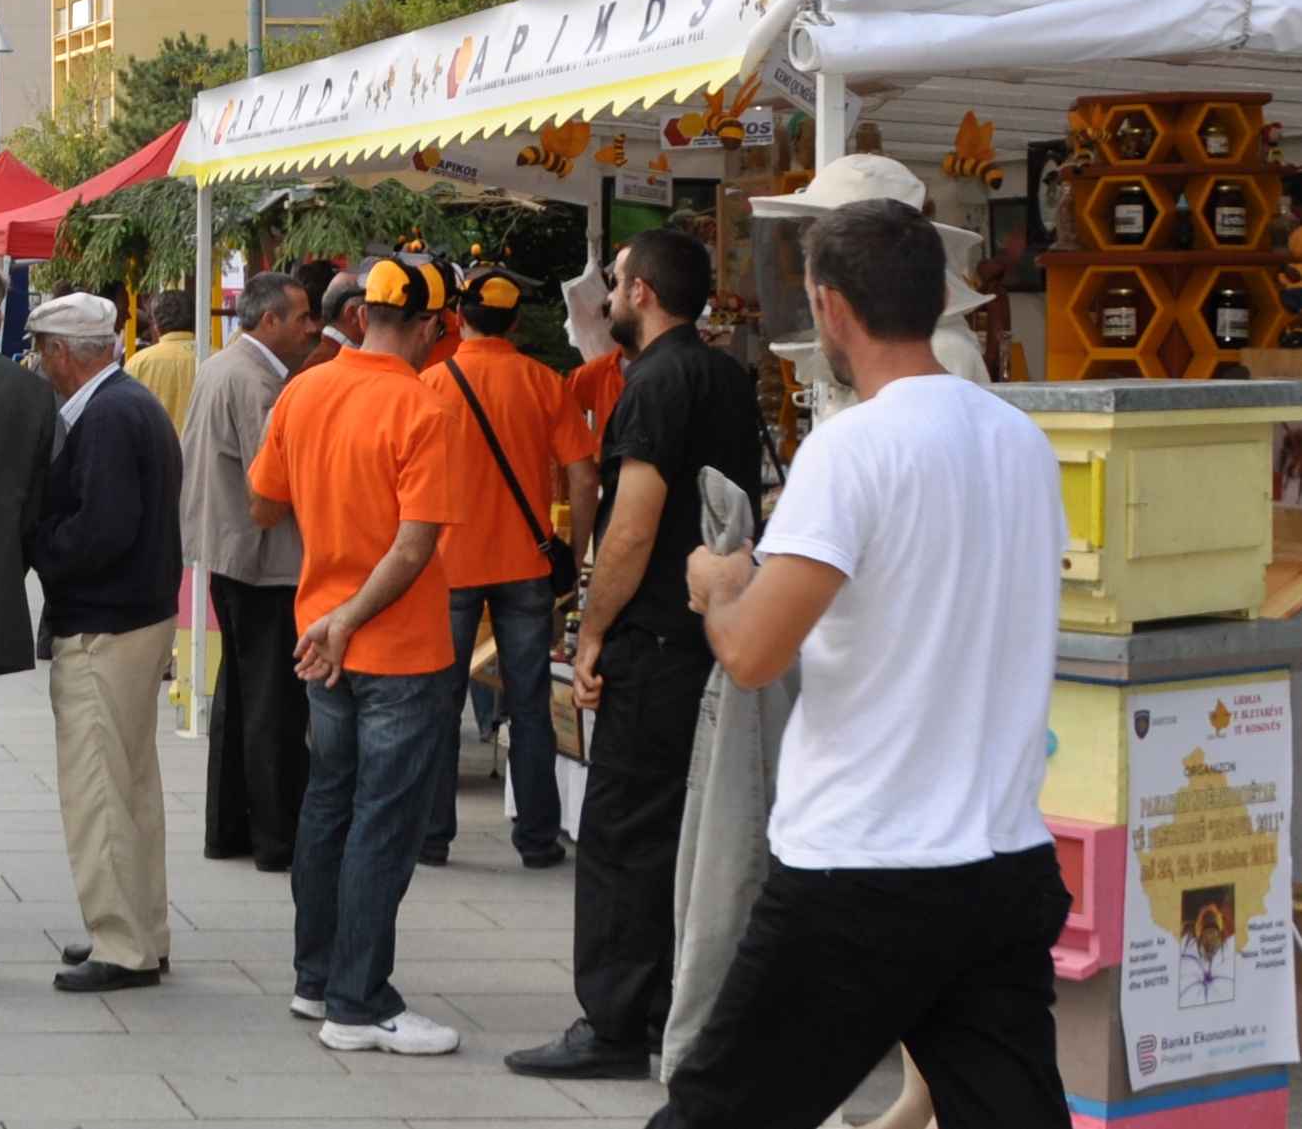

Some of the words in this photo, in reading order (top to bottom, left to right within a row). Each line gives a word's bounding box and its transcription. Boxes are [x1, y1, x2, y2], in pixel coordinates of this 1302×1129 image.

[437, 159, 478, 178] APIKOS
[1161, 1035, 1191, 1050] Banka
[1193, 1025, 1247, 1045] Ekonomike
